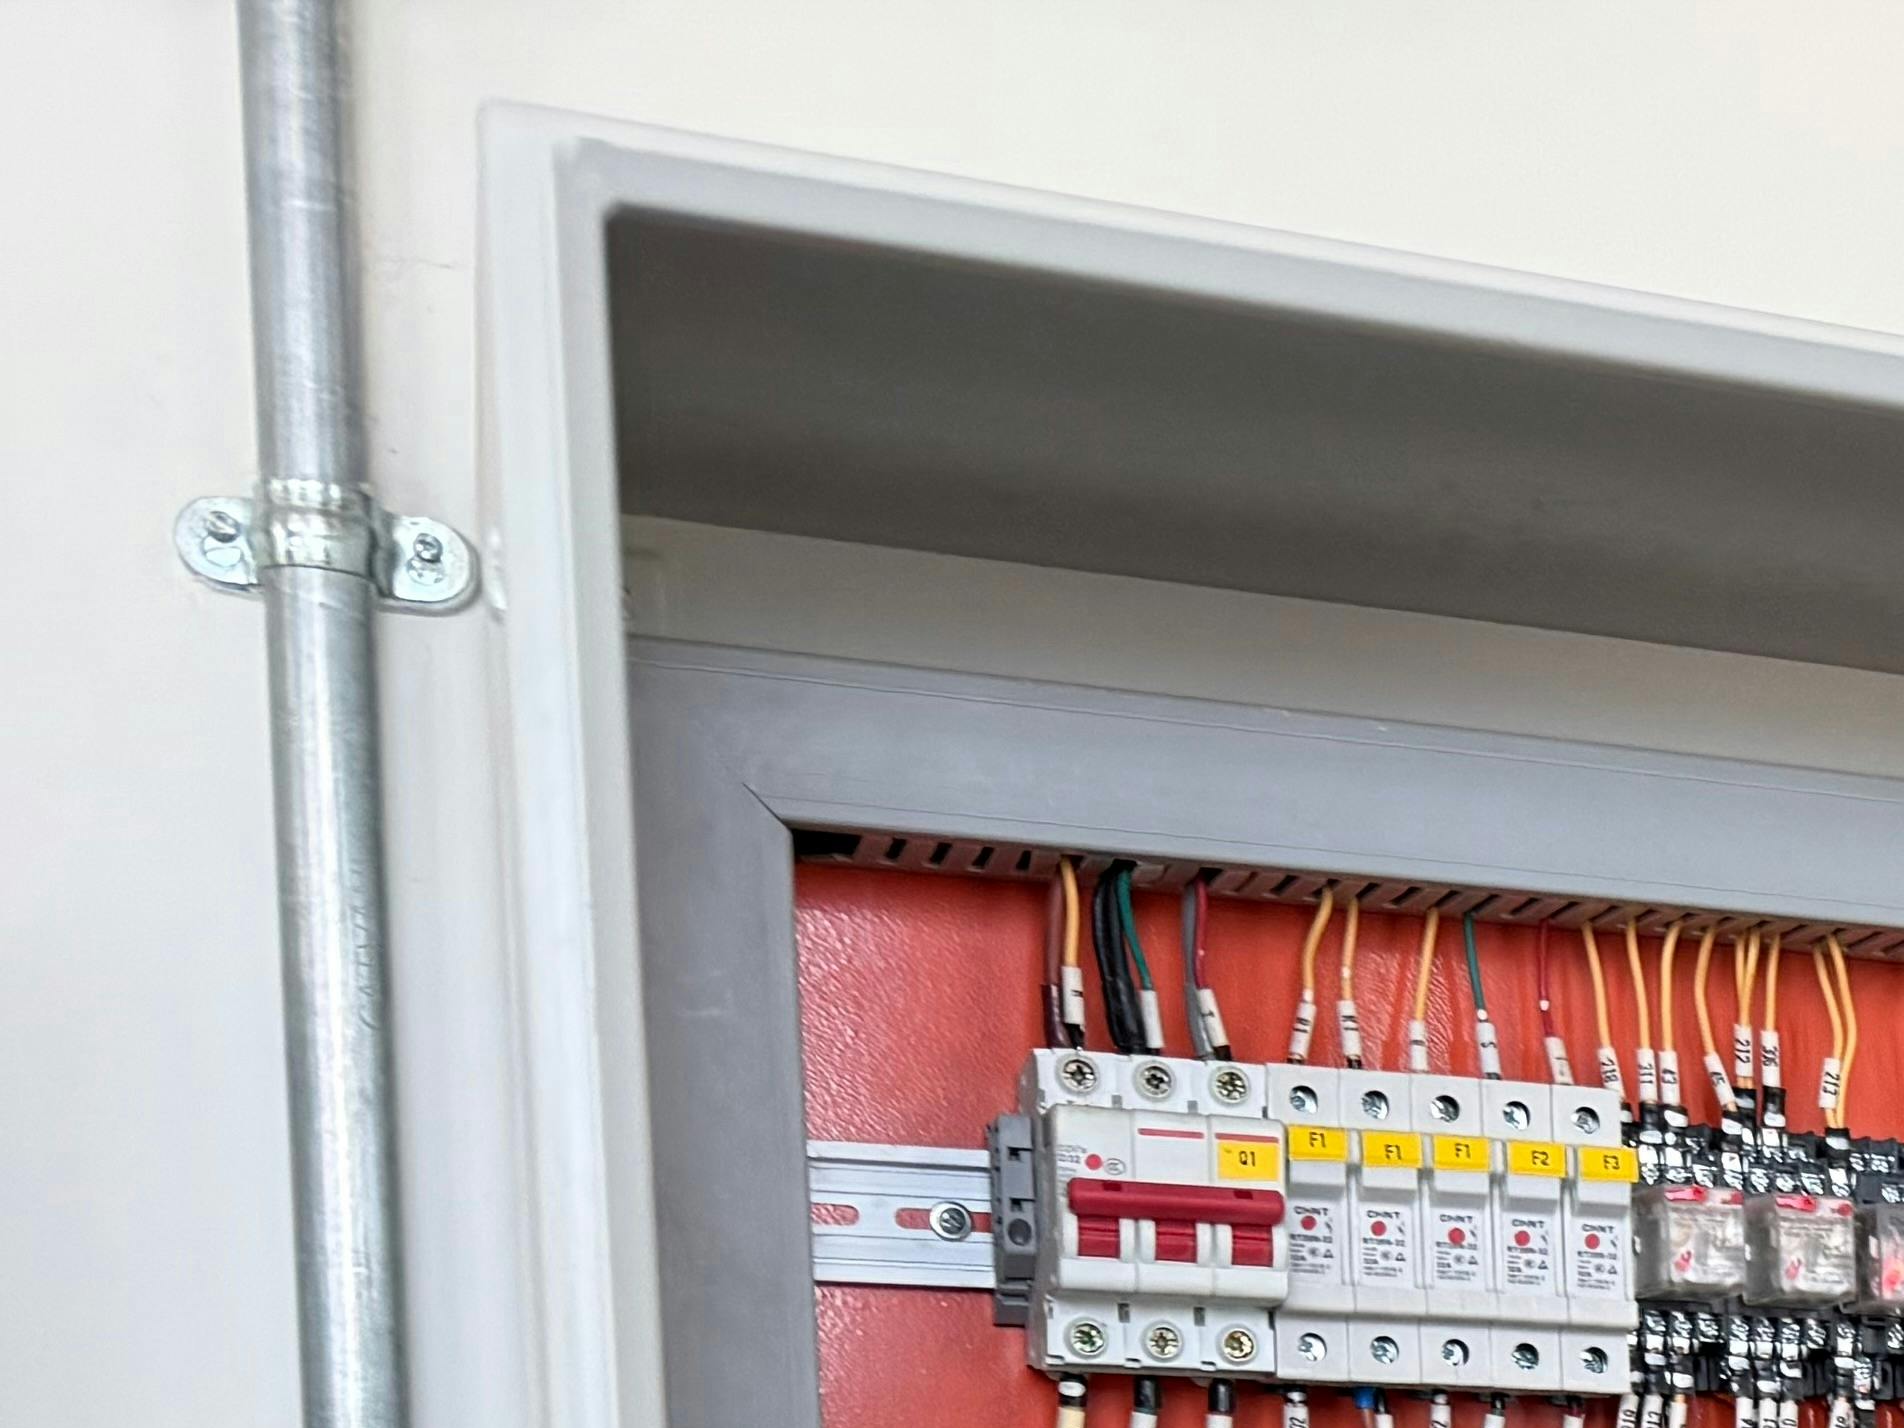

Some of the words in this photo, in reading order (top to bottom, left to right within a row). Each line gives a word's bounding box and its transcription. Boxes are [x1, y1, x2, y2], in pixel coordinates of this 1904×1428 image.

[1309, 1131, 1327, 1149] F1
[1238, 1150, 1257, 1168] Q1
[1385, 1144, 1401, 1161] F1
[1455, 1142, 1471, 1159] F1
[1531, 1150, 1549, 1167] F2
[1603, 1154, 1620, 1171] F3
